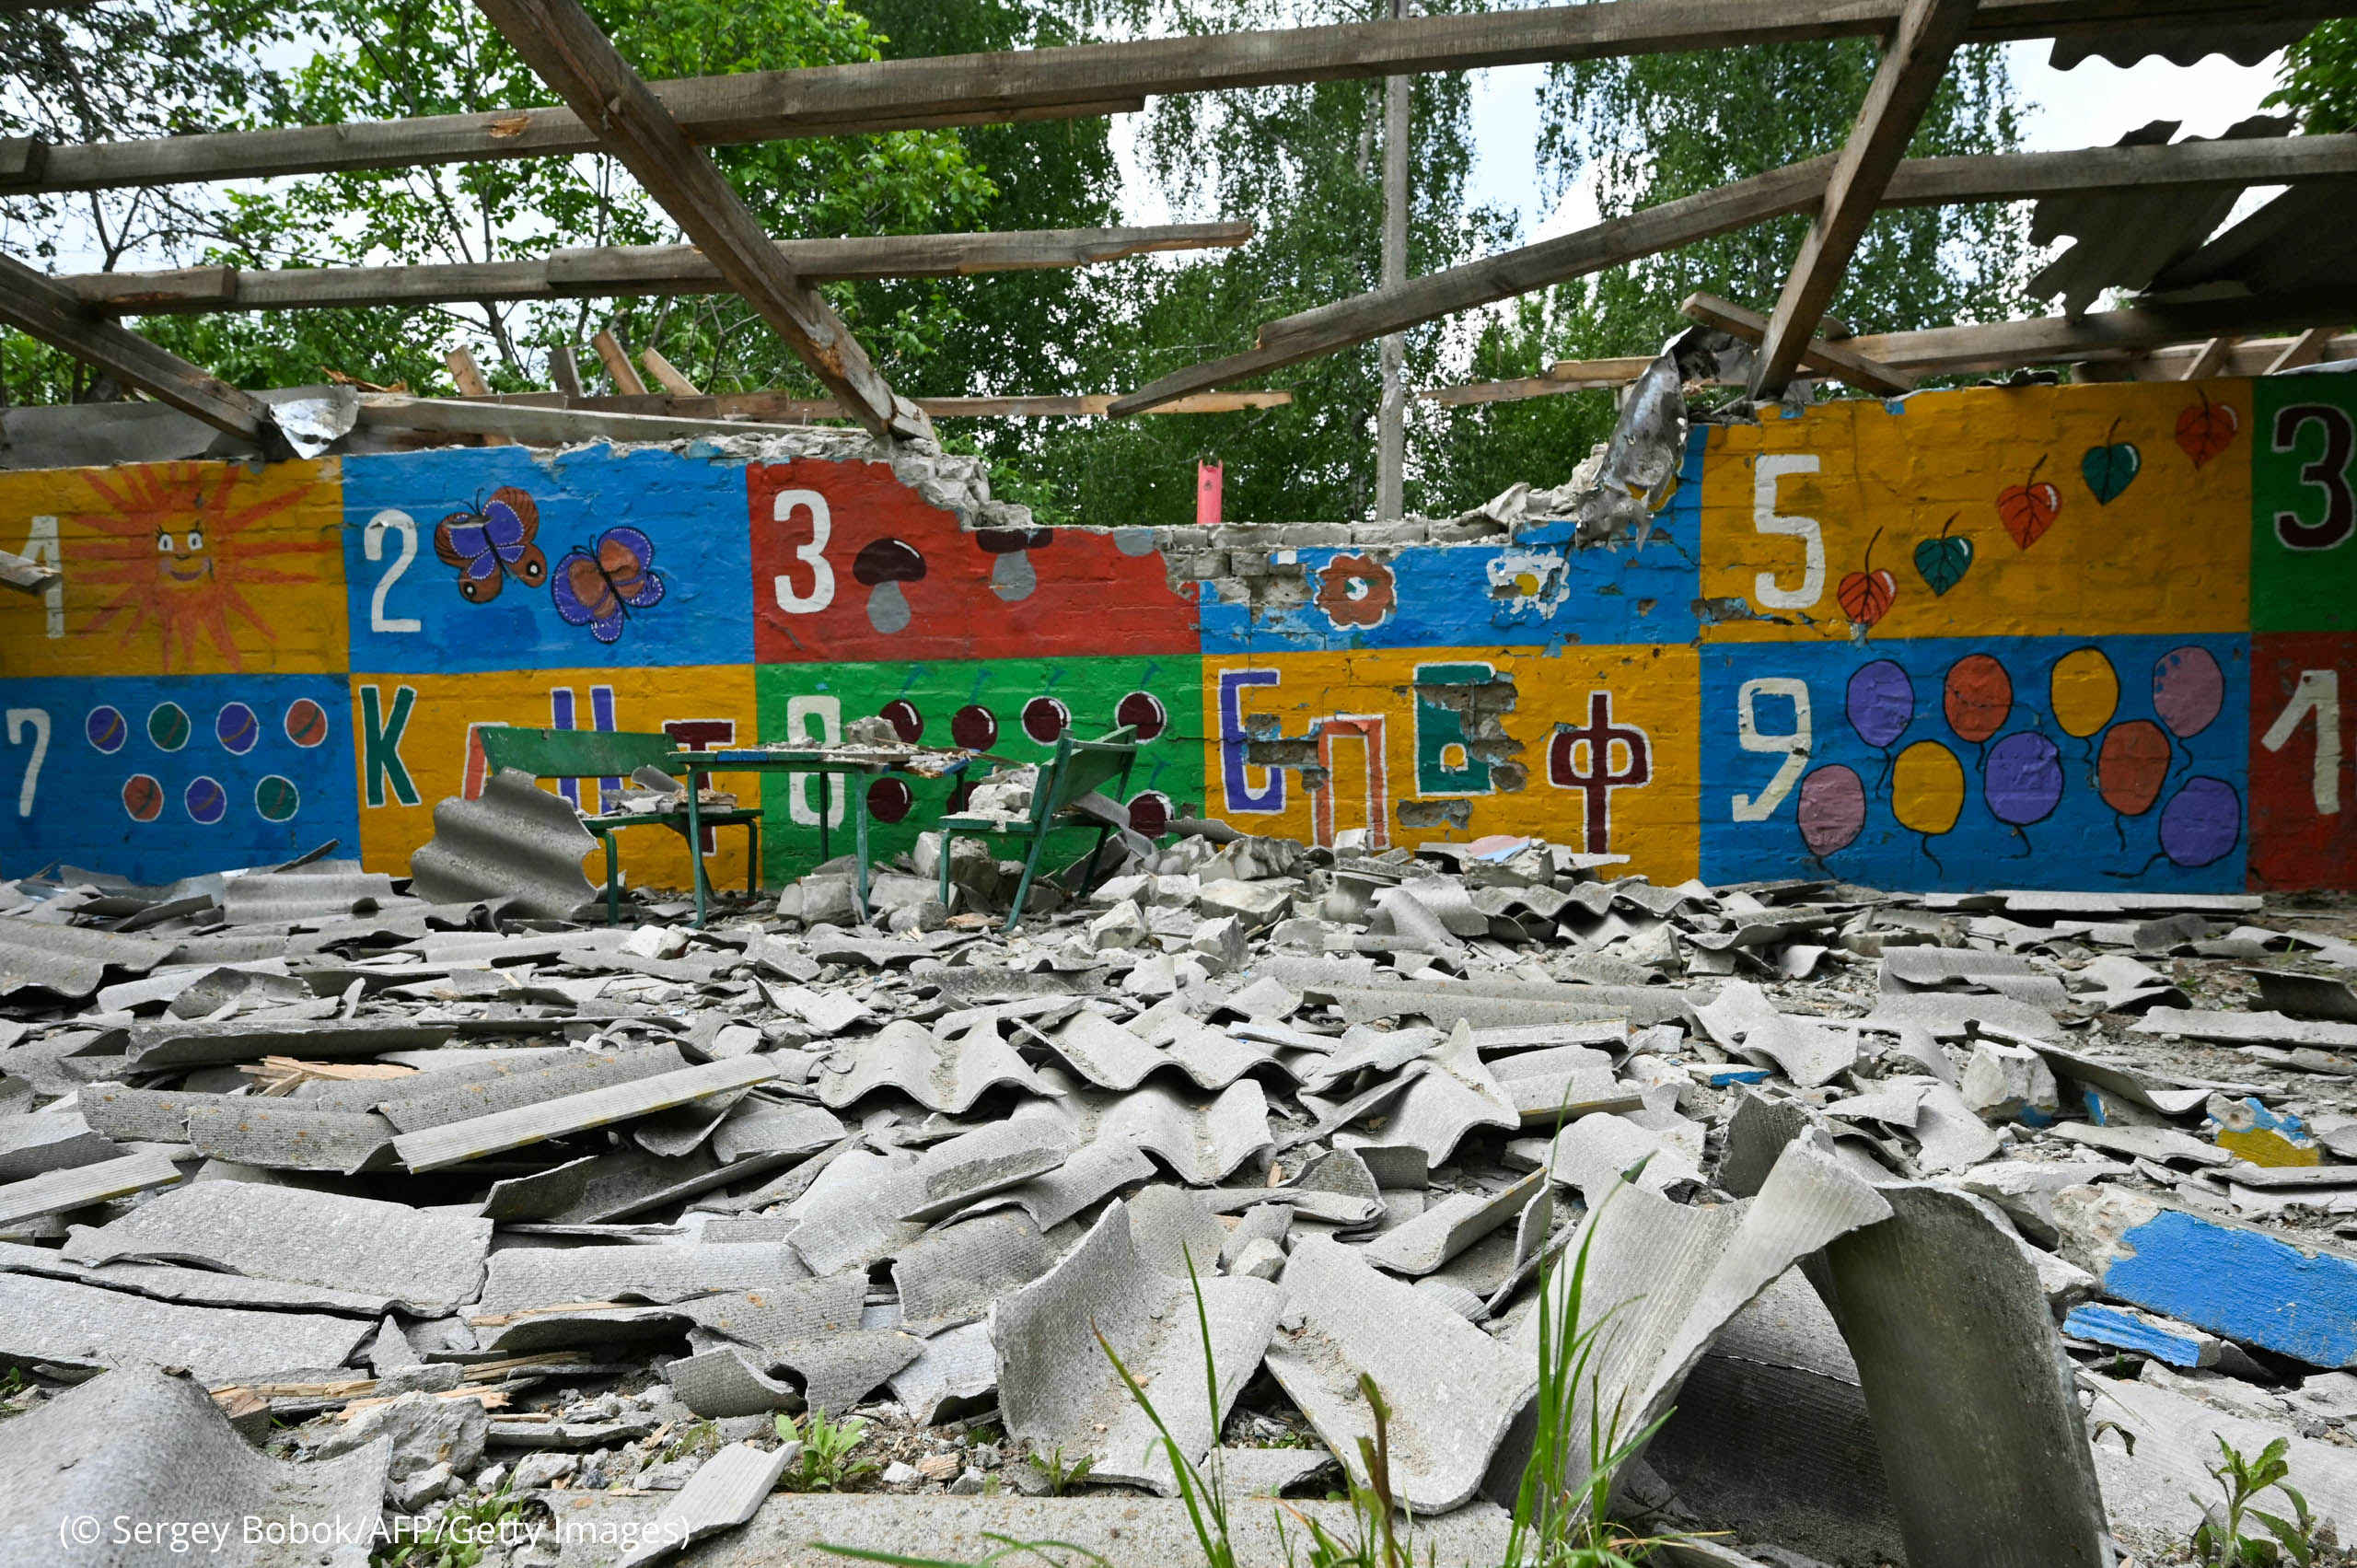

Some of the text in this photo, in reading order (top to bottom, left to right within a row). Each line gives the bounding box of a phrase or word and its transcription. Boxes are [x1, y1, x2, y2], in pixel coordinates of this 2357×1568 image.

[1753, 453, 1826, 610] 5
[2271, 402, 2356, 552] 3
[363, 508, 423, 633] 2
[772, 488, 836, 614] 3
[6, 707, 52, 818] 7
[1731, 677, 1812, 823] 9
